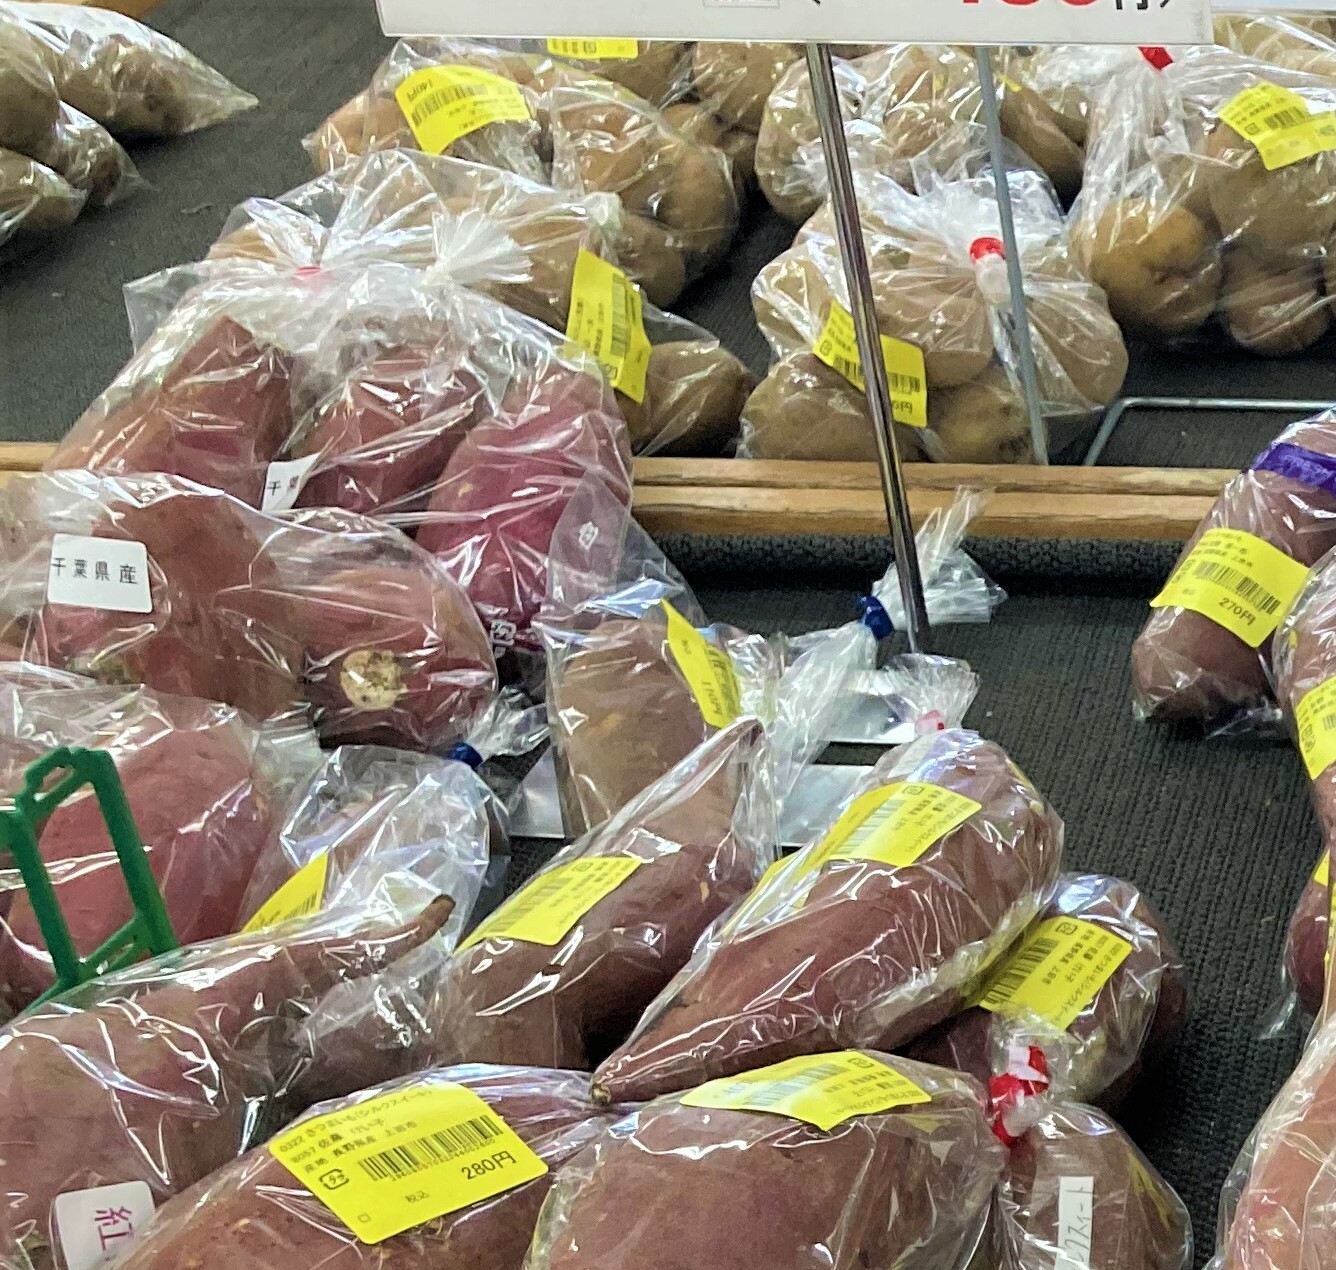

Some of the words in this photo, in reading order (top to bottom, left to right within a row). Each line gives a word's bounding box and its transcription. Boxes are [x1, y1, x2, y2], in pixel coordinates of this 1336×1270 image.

[51, 557, 138, 585] 千葉県産
[1219, 597, 1256, 626] 270円
[461, 1150, 517, 1181] 280円
[94, 1205, 135, 1252] 紅
